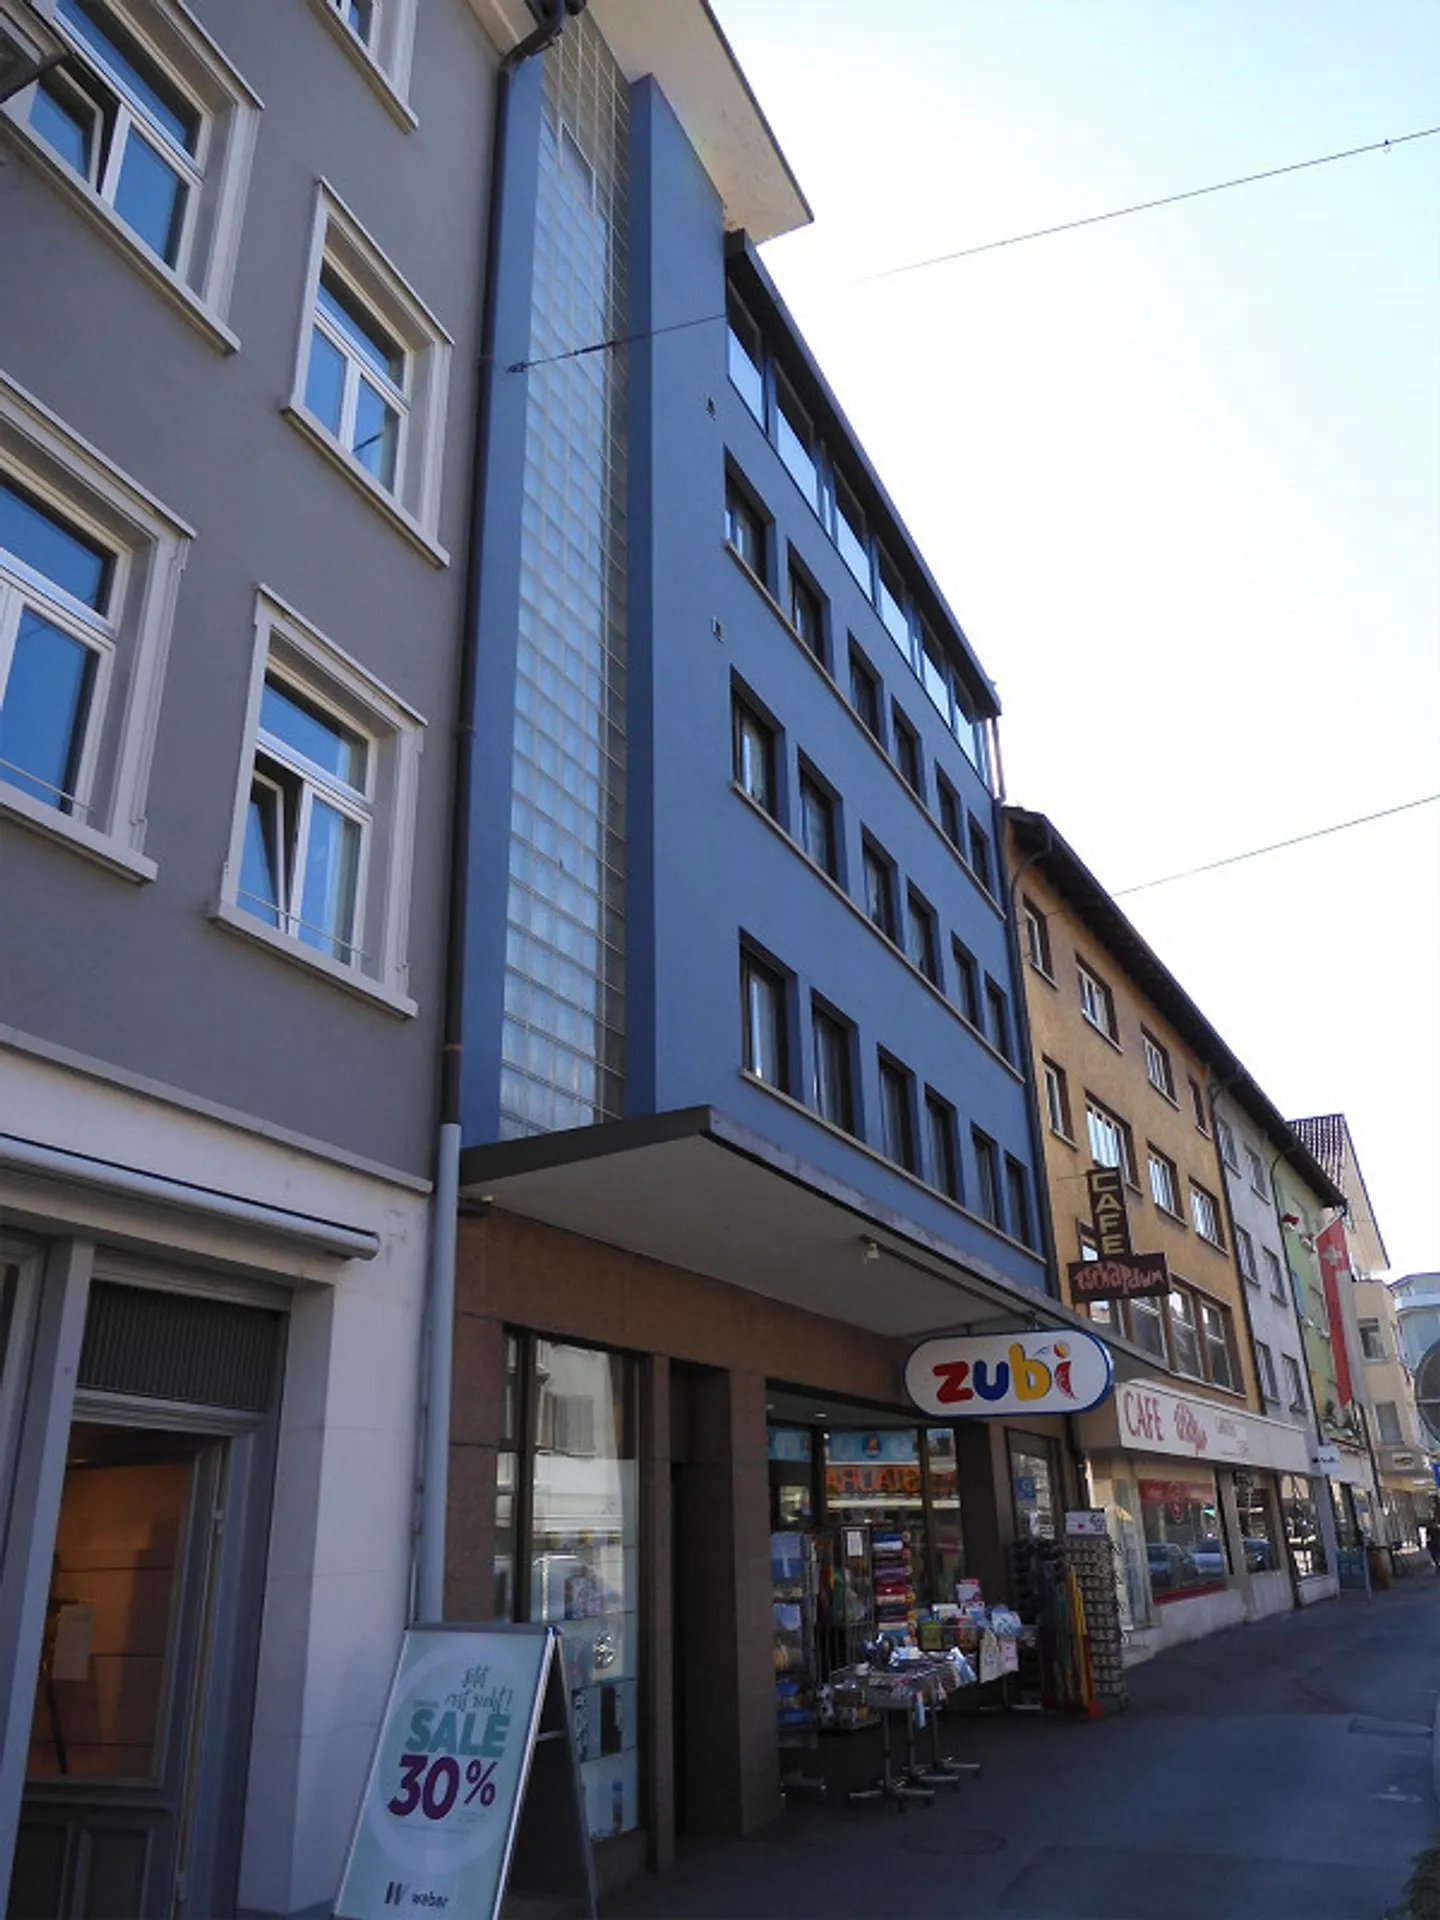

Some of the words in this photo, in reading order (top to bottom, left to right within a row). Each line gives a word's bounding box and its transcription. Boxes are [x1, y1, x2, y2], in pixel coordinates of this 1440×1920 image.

[932, 1341, 1079, 1404] zubi
[404, 1707, 512, 1758] SALE
[387, 1753, 498, 1821] 30%
[411, 1890, 449, 1909] weber
